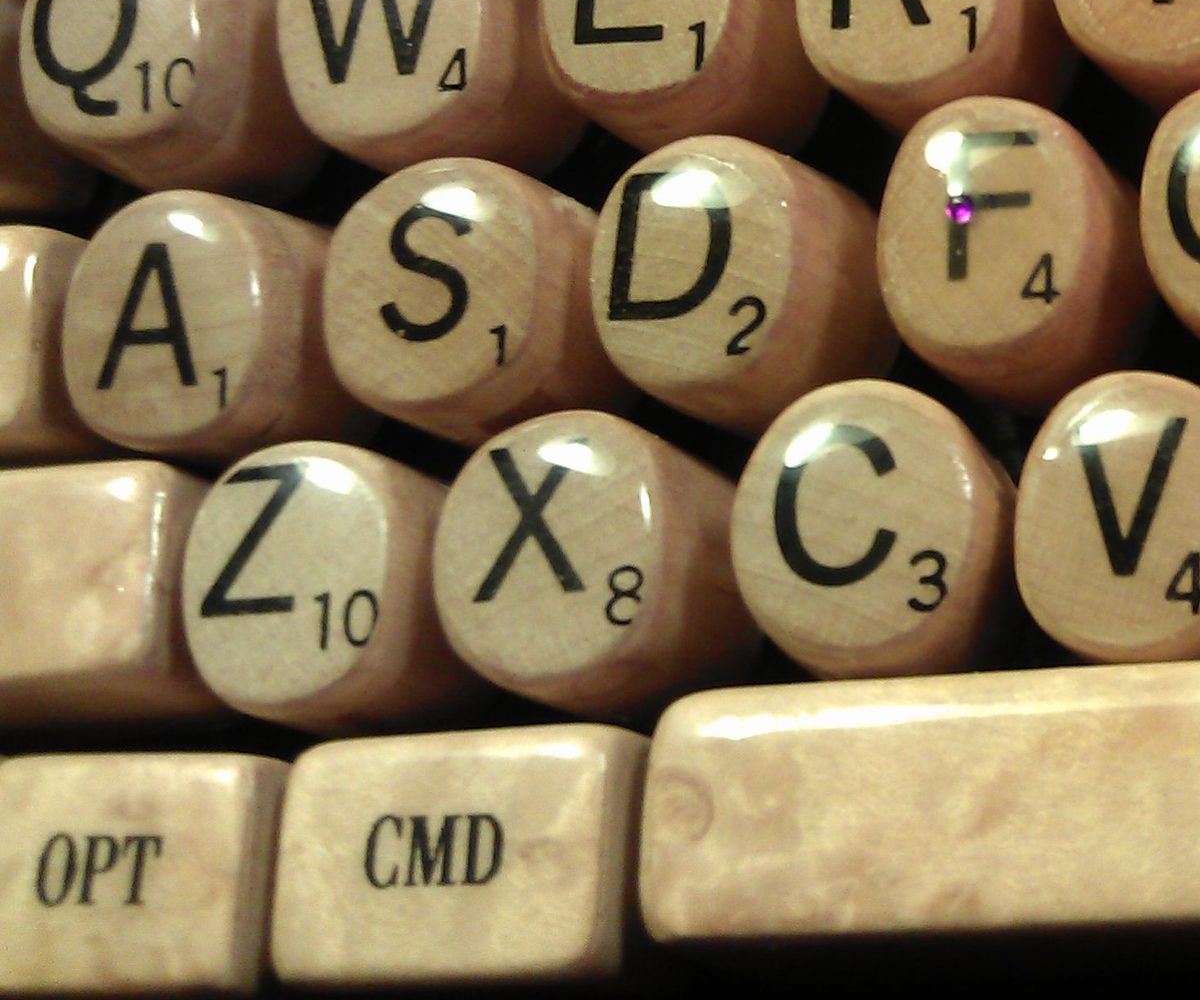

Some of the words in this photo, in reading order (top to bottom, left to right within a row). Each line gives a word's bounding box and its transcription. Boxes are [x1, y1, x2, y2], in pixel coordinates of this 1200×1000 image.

[437, 48, 468, 92] 4
[687, 21, 706, 72] 1
[960, 6, 977, 53] 1
[379, 202, 472, 342] S
[489, 324, 507, 367] 1
[607, 172, 732, 322] D
[725, 295, 767, 356] 2
[943, 130, 1039, 282] F
[1021, 253, 1060, 305] 4
[96, 242, 198, 391] A
[212, 368, 229, 409] 1
[201, 462, 310, 618] Z
[313, 589, 380, 651] 10
[472, 438, 590, 604] X
[605, 565, 643, 626] 8
[774, 424, 897, 587] C
[907, 550, 949, 613] 3
[1072, 417, 1187, 577] V
[34, 833, 164, 908] OPT
[363, 812, 505, 890] CMD
